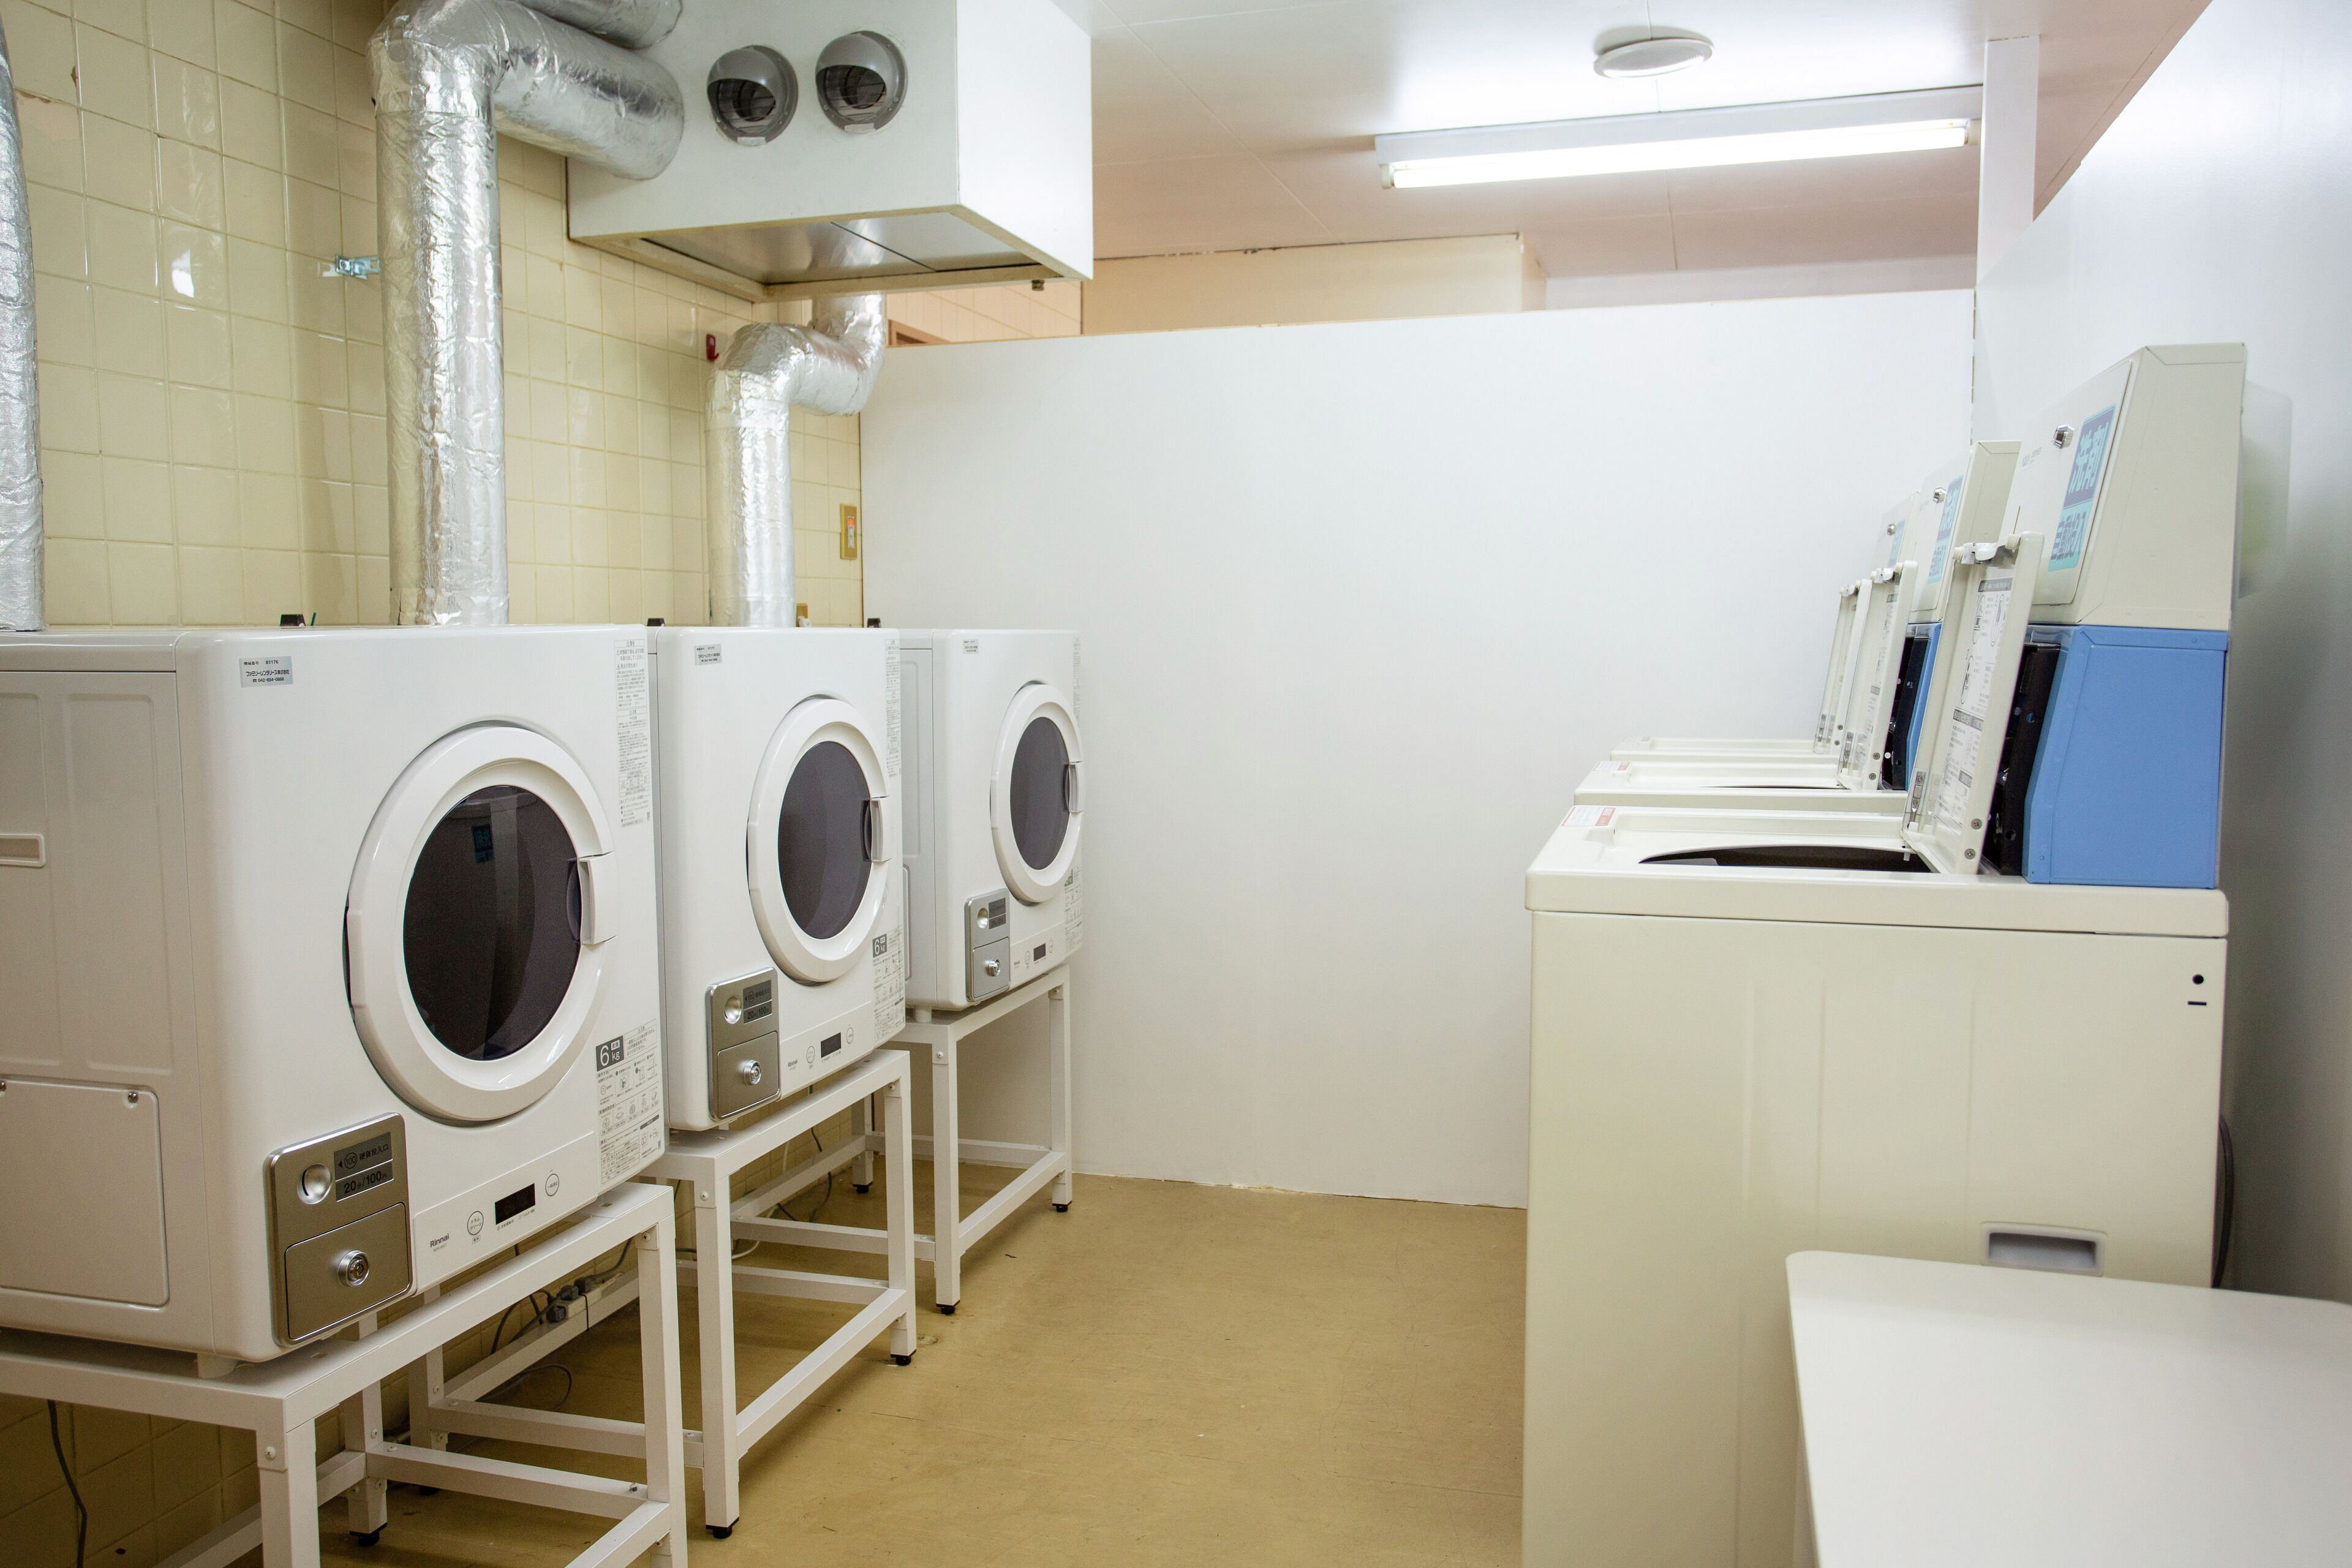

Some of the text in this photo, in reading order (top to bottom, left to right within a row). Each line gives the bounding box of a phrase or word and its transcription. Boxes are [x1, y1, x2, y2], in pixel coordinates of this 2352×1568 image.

[600, 1045, 609, 1066] 6
[612, 1051, 620, 1061] kg
[359, 1144, 389, 1161] 硬貨投入口
[430, 1233, 450, 1248] Rinnai
